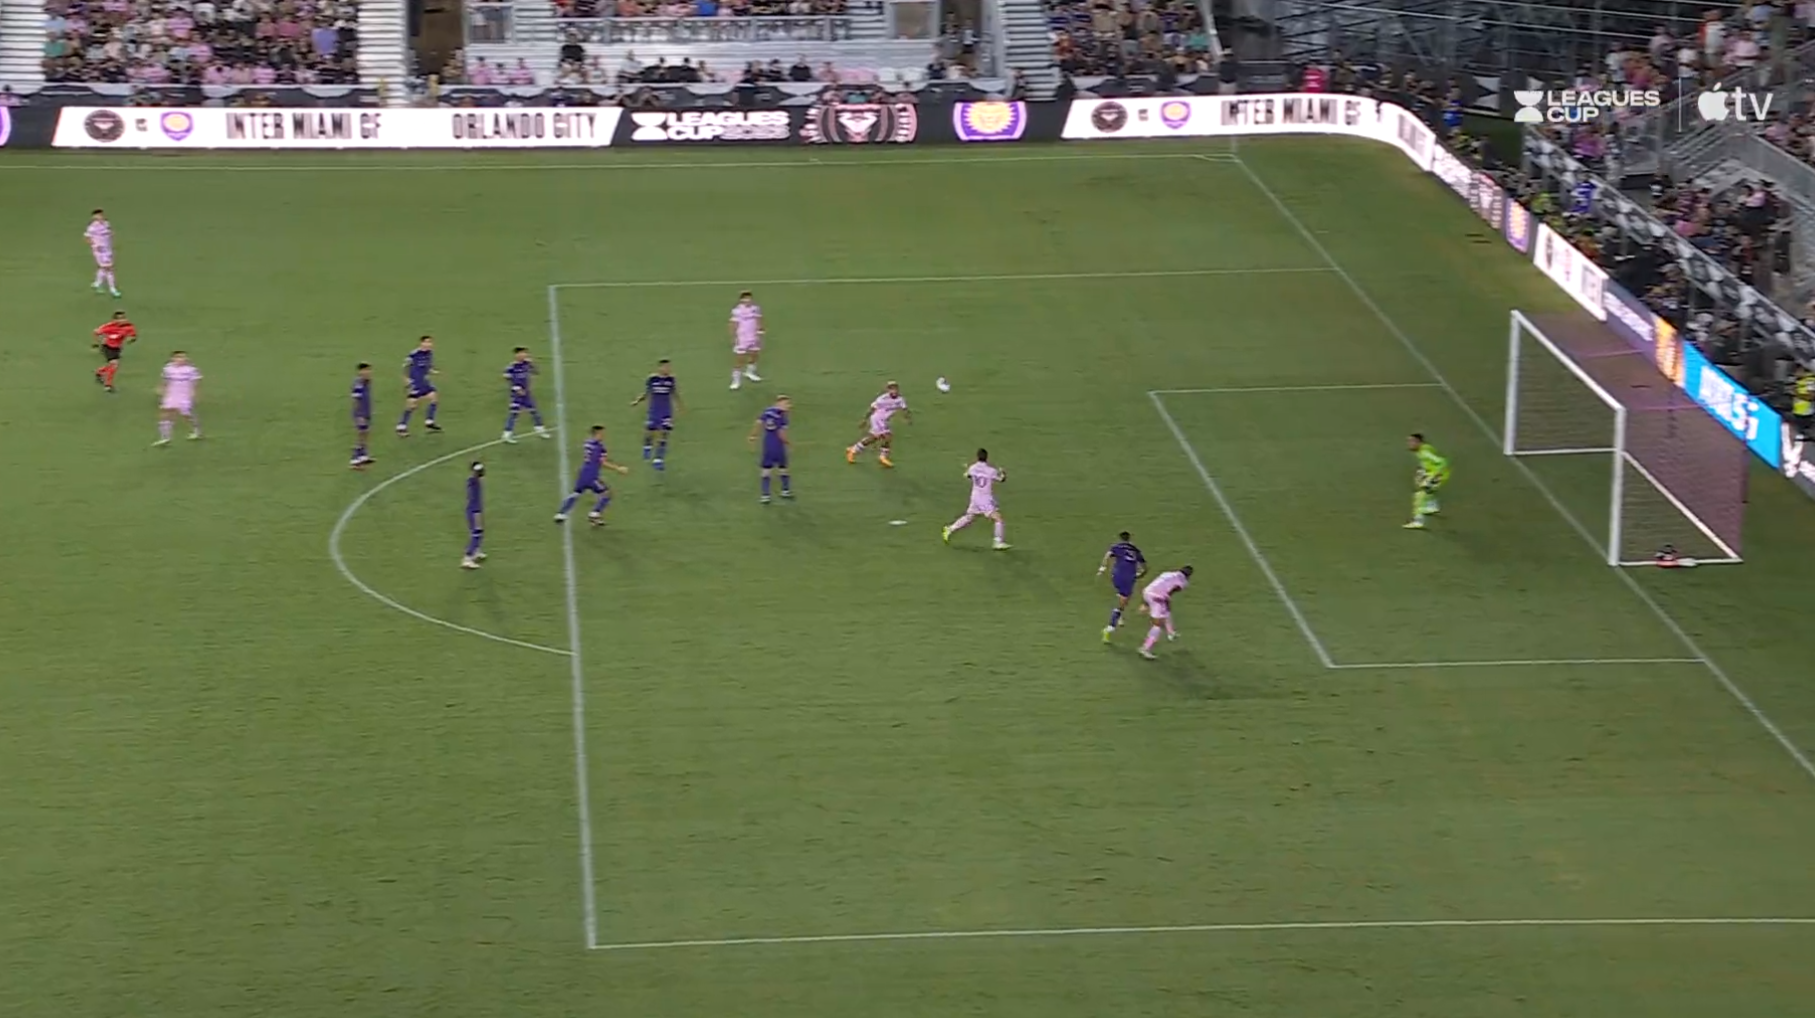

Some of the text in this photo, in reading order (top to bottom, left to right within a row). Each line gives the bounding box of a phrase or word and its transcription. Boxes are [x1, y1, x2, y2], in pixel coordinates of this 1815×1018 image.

[226, 113, 284, 139] INTER
[292, 113, 352, 139] MIAMI
[453, 113, 545, 139] ORLANDO
[666, 111, 790, 126] LEAGUES
[667, 125, 724, 140] CUP
